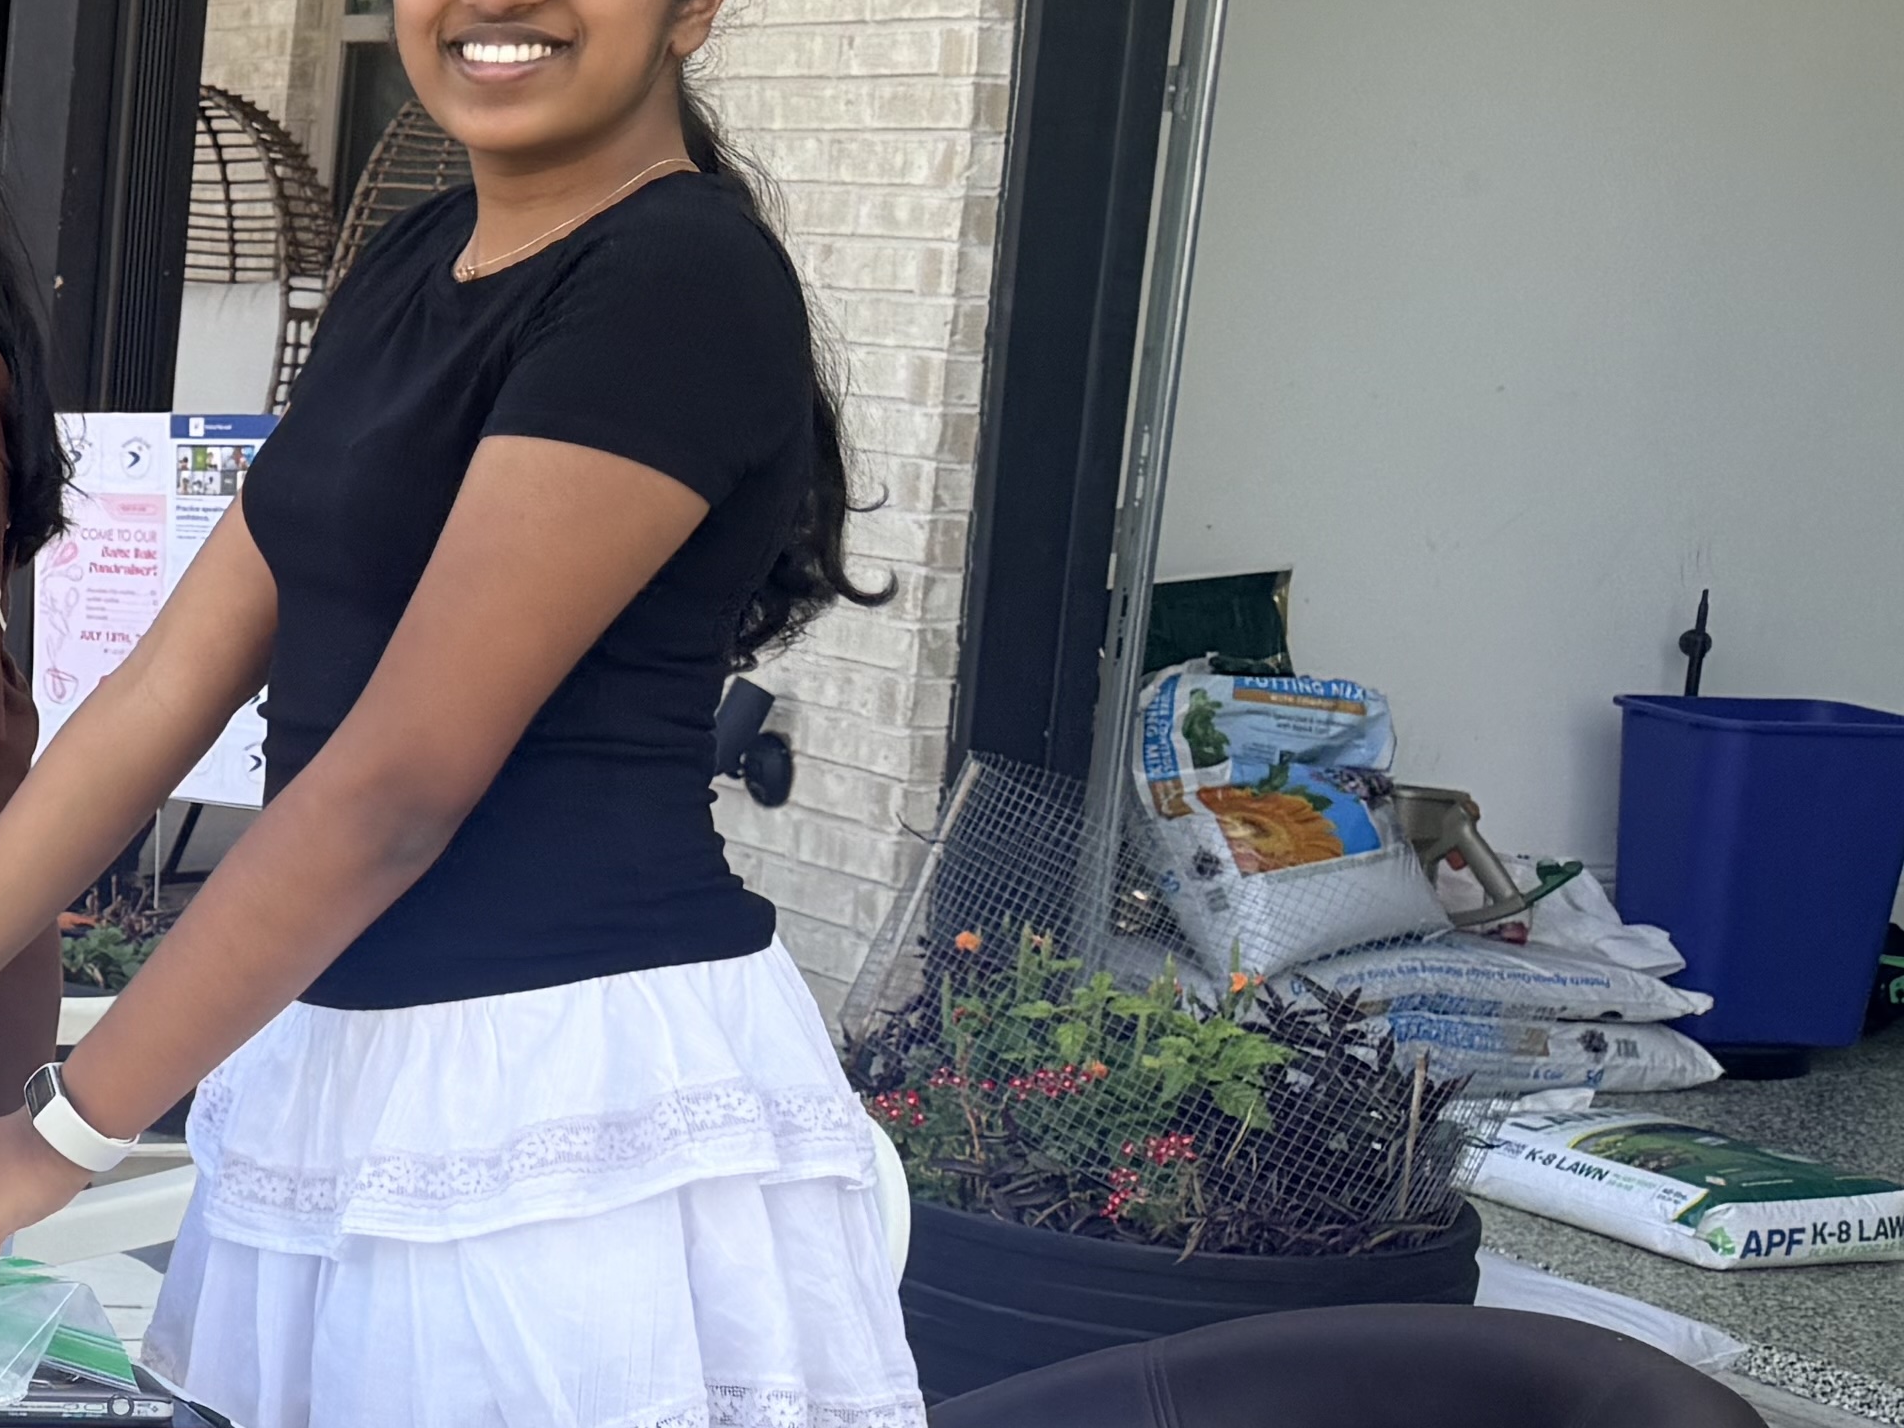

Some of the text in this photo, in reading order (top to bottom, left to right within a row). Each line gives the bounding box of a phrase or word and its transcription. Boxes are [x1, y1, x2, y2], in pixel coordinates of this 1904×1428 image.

[80, 527, 158, 544] COME TO OUR
[1524, 1147, 1555, 1166] K-8
[1555, 1157, 1610, 1182] LAWN
[1740, 1227, 1806, 1260] APF
[1811, 1220, 1851, 1245] K-8
